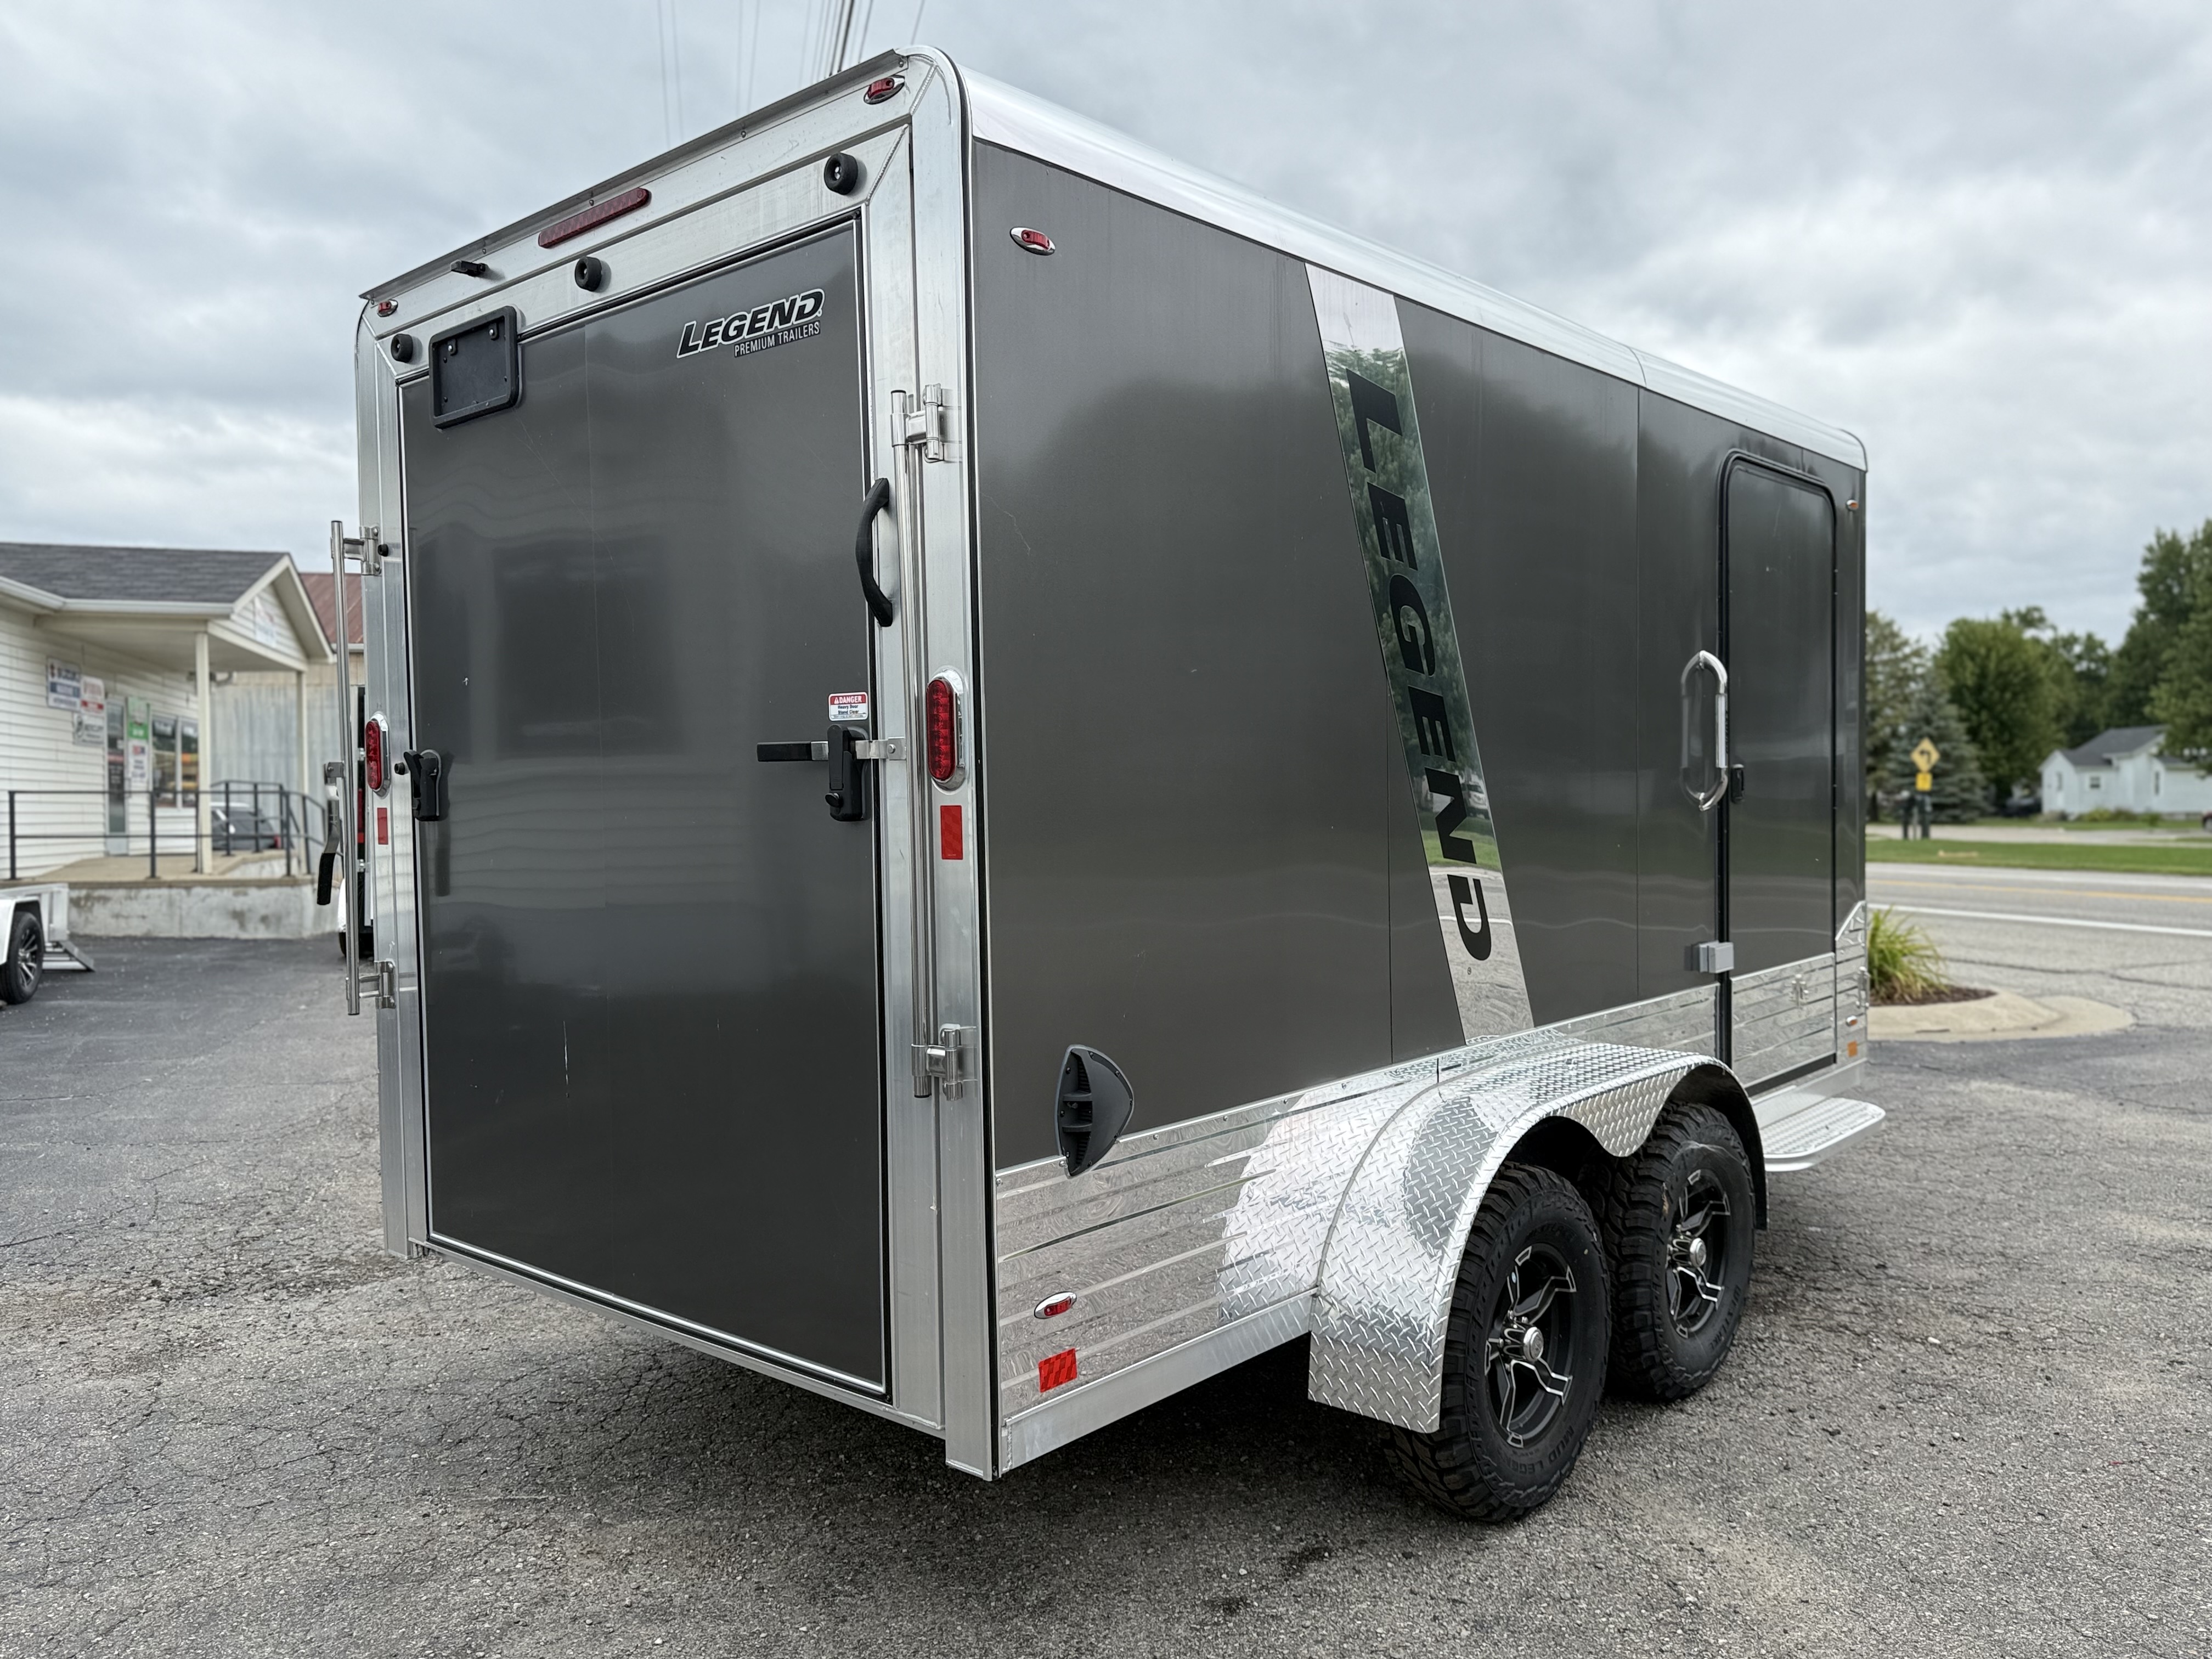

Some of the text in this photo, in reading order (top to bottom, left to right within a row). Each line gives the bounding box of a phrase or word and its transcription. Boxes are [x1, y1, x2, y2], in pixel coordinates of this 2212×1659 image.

[677, 289, 825, 358] LEGEND
[735, 321, 820, 357] PREMIUM TRAILERS
[1346, 368, 1492, 961] LEGEND
[839, 696, 862, 704] DANGER
[1548, 1425, 1575, 1464] MUD
